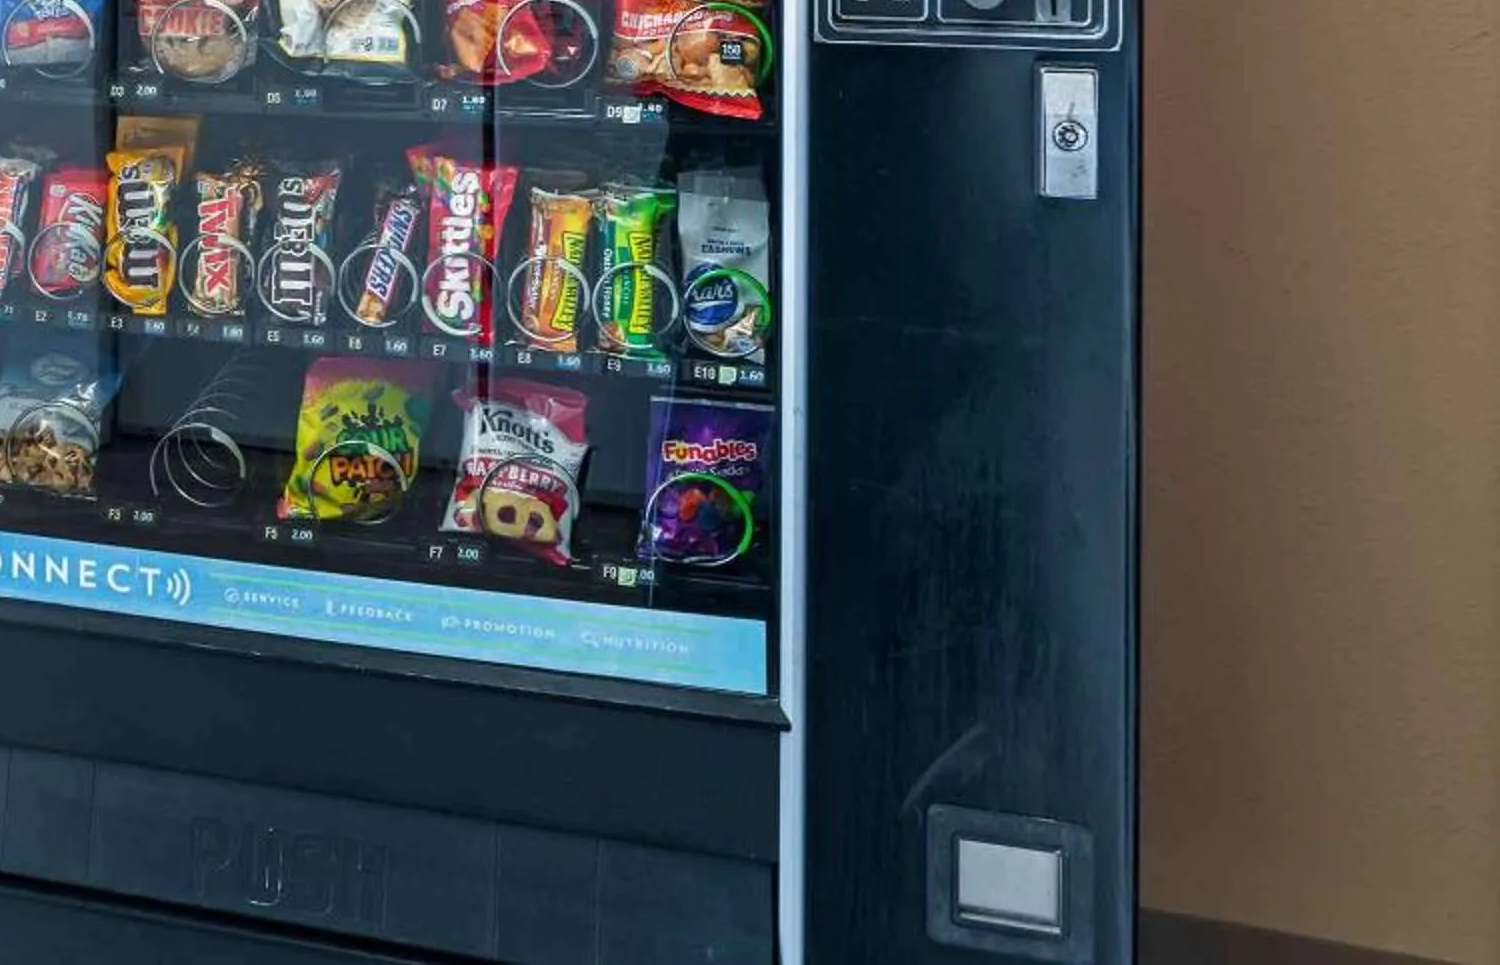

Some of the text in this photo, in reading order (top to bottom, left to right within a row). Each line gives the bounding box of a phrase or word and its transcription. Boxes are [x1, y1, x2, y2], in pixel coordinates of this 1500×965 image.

[198, 185, 240, 295] TWIX
[433, 345, 446, 356] E7
[694, 366, 717, 380] E10
[481, 407, 555, 455] Knott's
[663, 439, 757, 464] Funables
[291, 528, 313, 540] 2.00
[429, 546, 443, 559] F7
[603, 566, 617, 580] F9
[242, 591, 691, 654] SERVICE FEEDBACK PROMOTION NUTRITION
